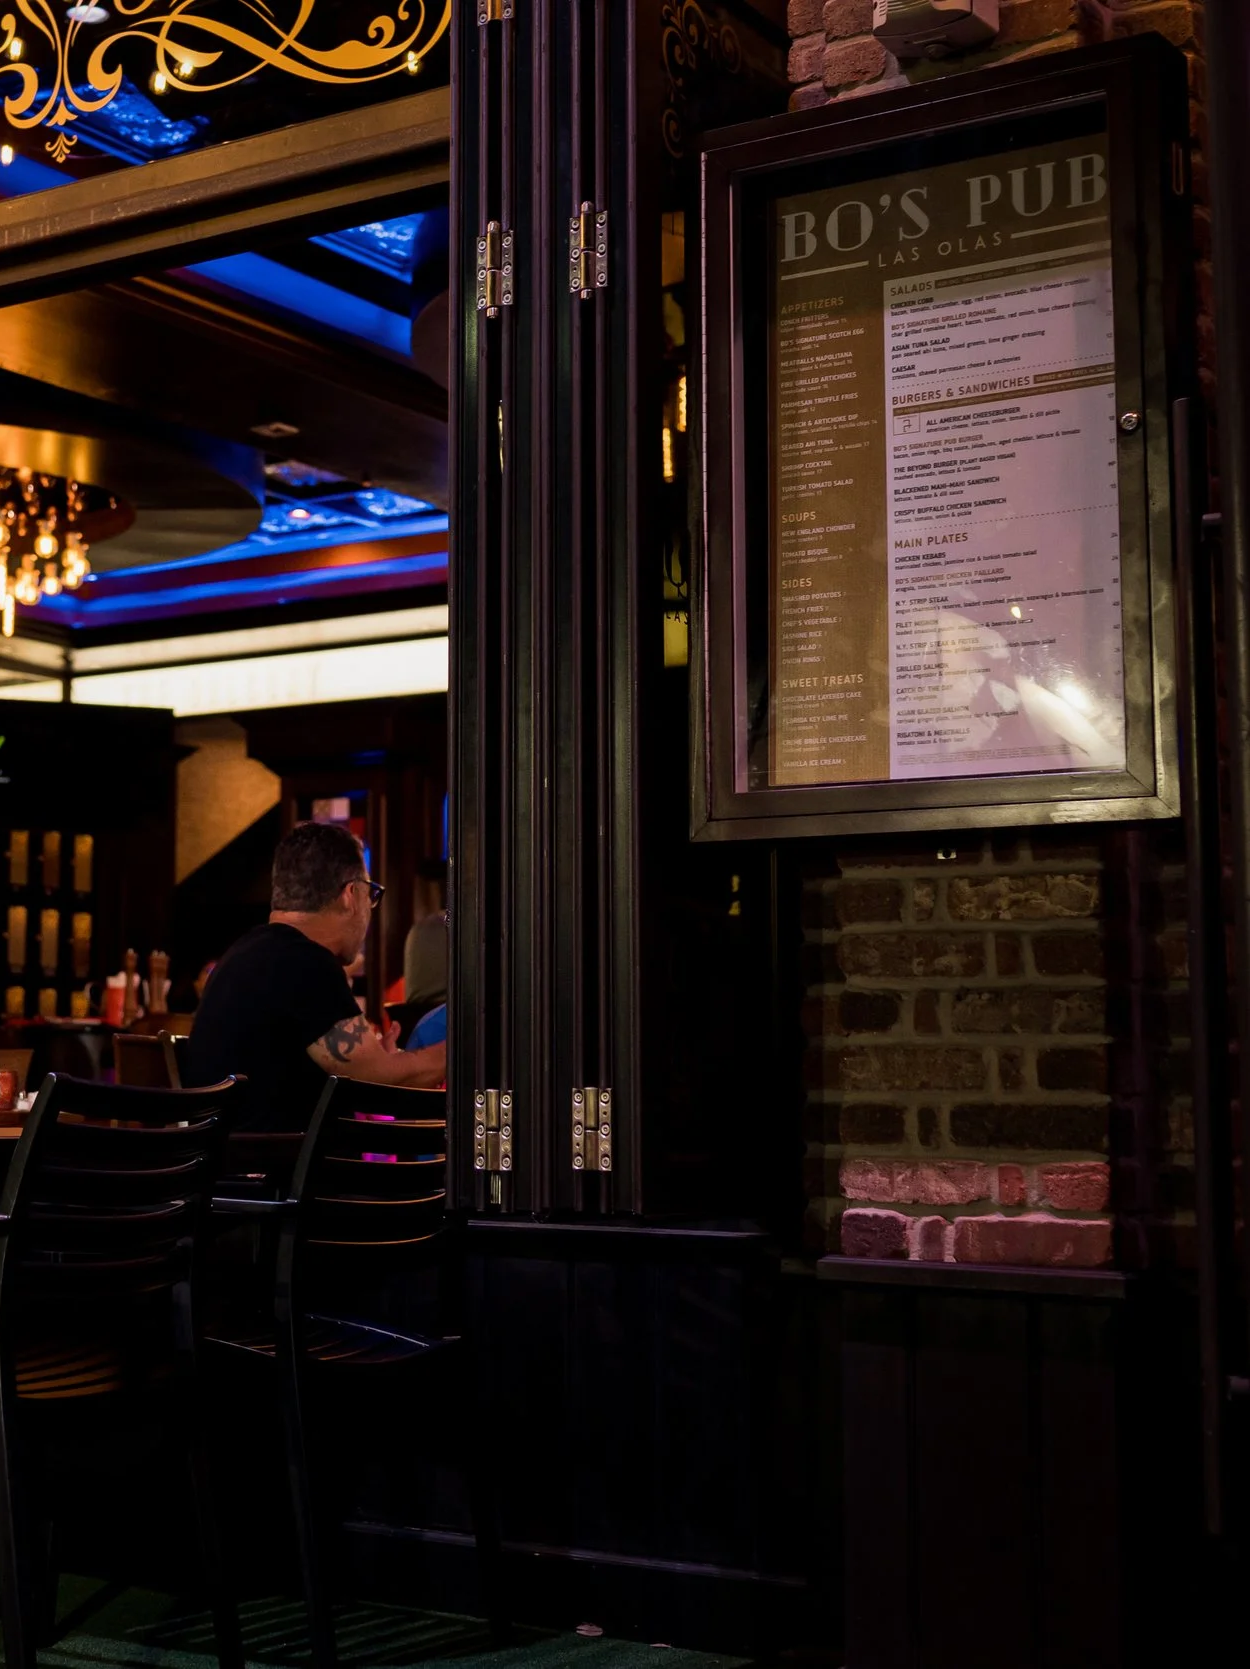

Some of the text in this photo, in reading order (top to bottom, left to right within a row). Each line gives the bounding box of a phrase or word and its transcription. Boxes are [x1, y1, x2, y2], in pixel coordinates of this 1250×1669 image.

[781, 153, 1107, 262] BO'S PUB
[878, 231, 1002, 267] LAS OLAS
[890, 281, 932, 296] SALADS
[781, 295, 843, 315] APPETIZERS
[892, 337, 950, 351] ASIAN TUNA SALAD
[892, 364, 915, 373] CAESAR
[892, 376, 1029, 405] BURGERS & SANDWICHES
[939, 414, 970, 424] AMERICAN
[972, 407, 1020, 419] CHEESEBURGER
[907, 463, 931, 471] BEYOND
[933, 460, 957, 468] BURGER
[781, 510, 816, 523] SOUPS
[894, 532, 967, 549] MAIN PLATES
[895, 552, 945, 562] CHICKEN KEBABS
[781, 577, 811, 589] SIDES
[782, 673, 863, 688] SWEET TREATS
